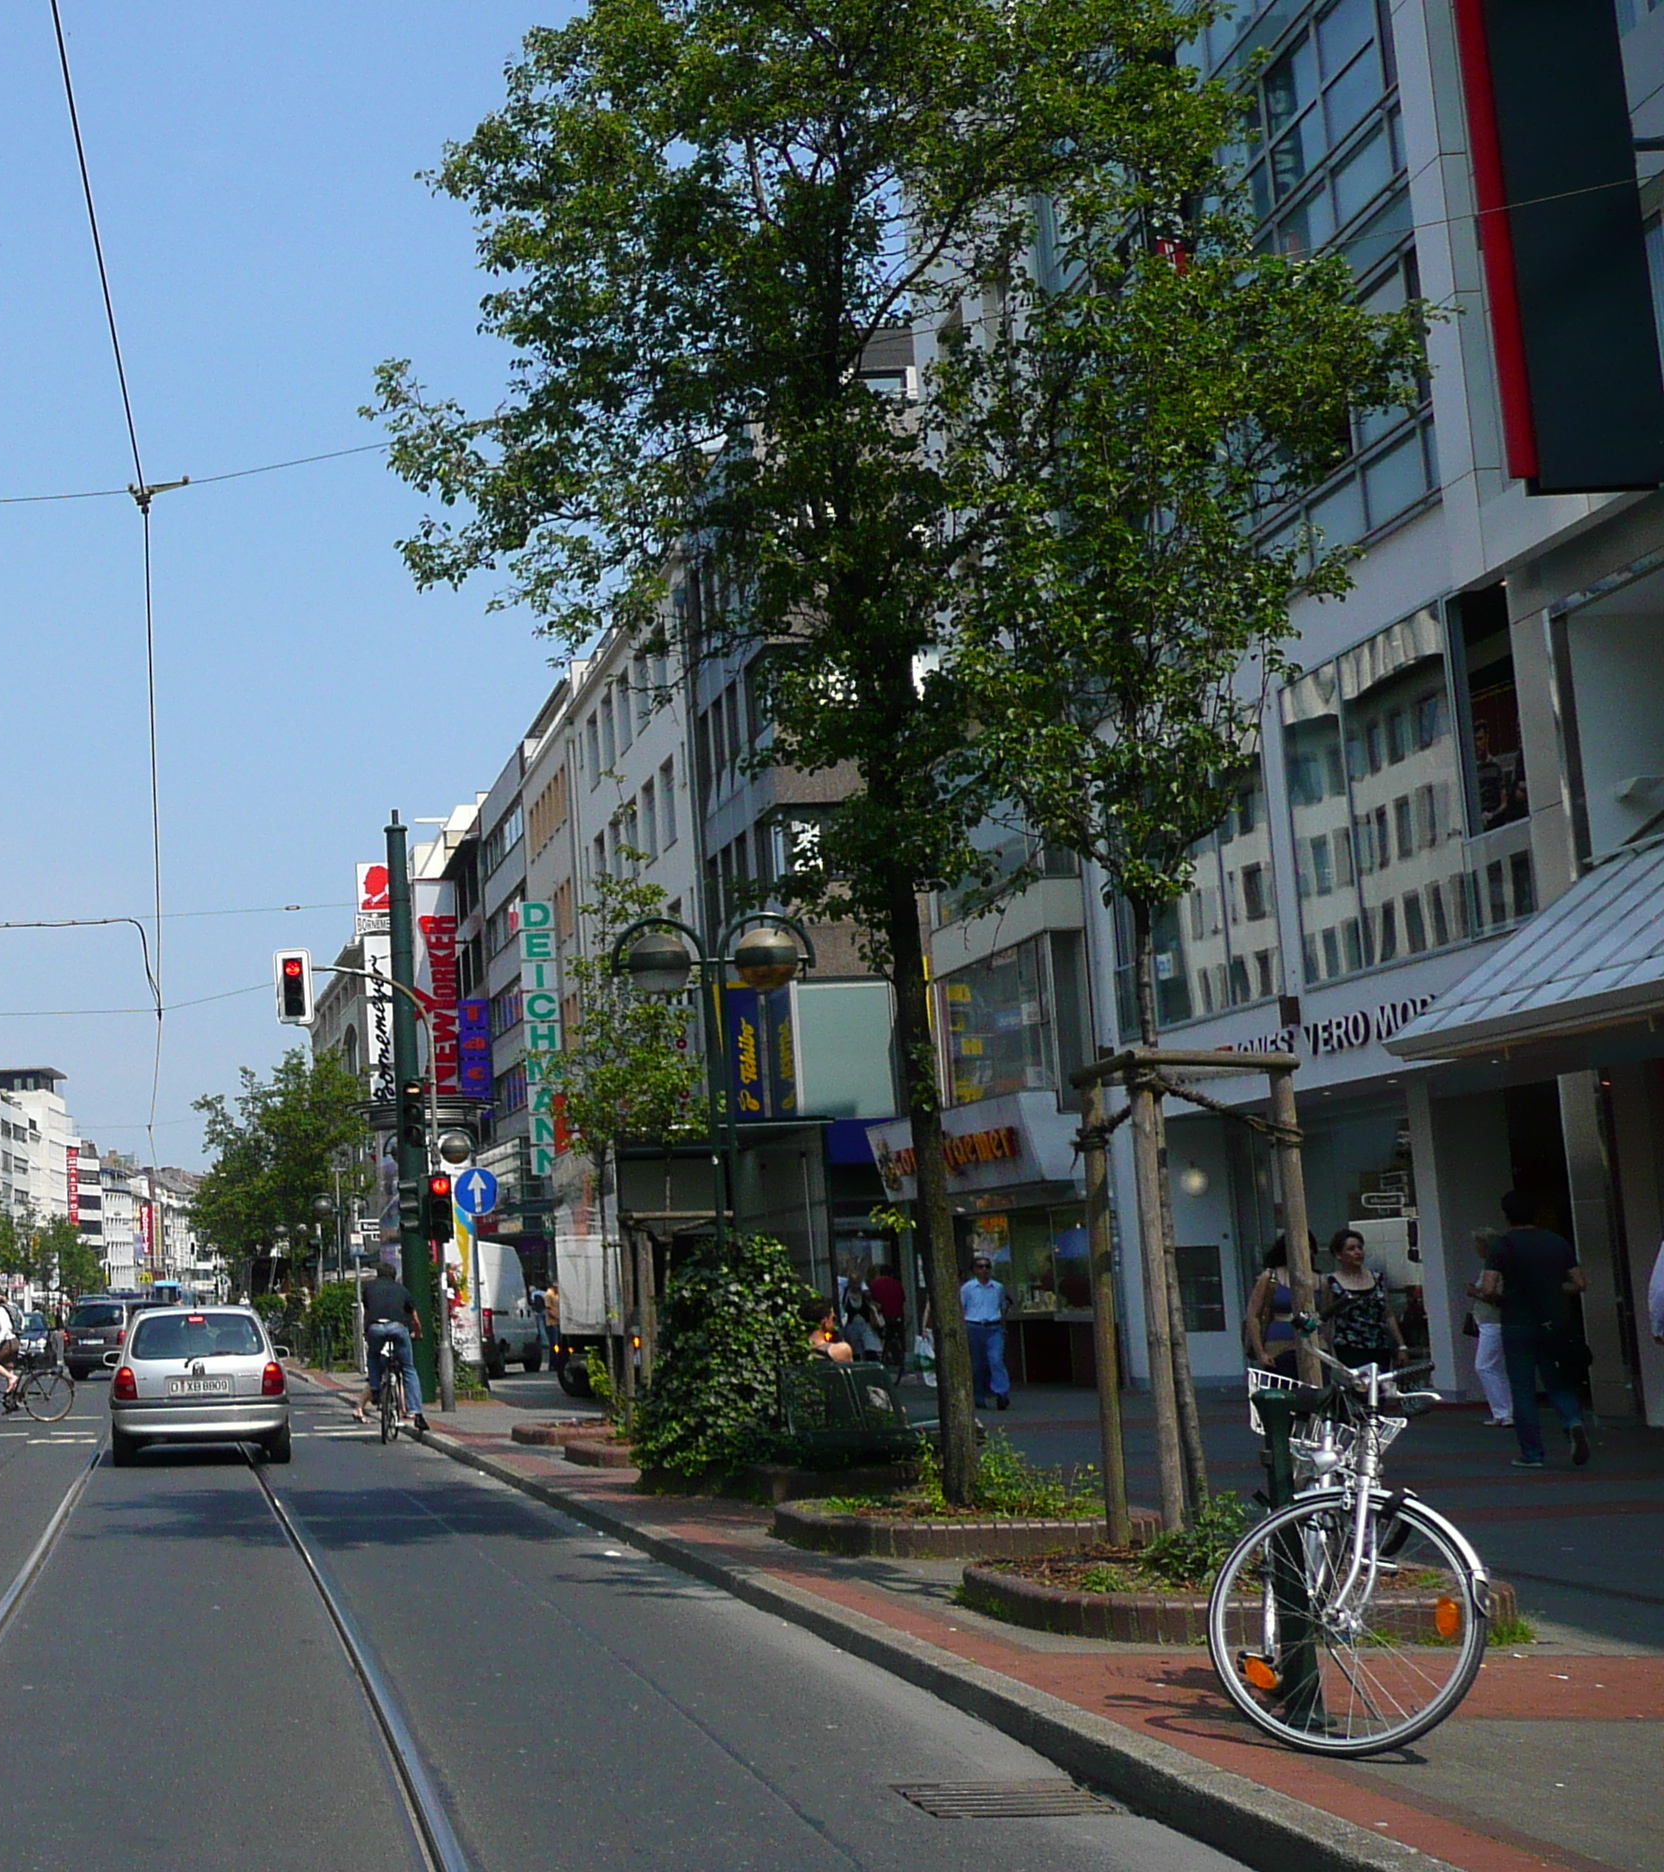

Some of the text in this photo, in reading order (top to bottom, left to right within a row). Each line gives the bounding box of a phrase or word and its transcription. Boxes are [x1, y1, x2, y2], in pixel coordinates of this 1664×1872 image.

[357, 917, 391, 932] BORNEME
[523, 902, 561, 1175] DEICHMANN
[738, 1016, 758, 1085] Tchibo
[1303, 993, 1436, 1055] VERO MOD
